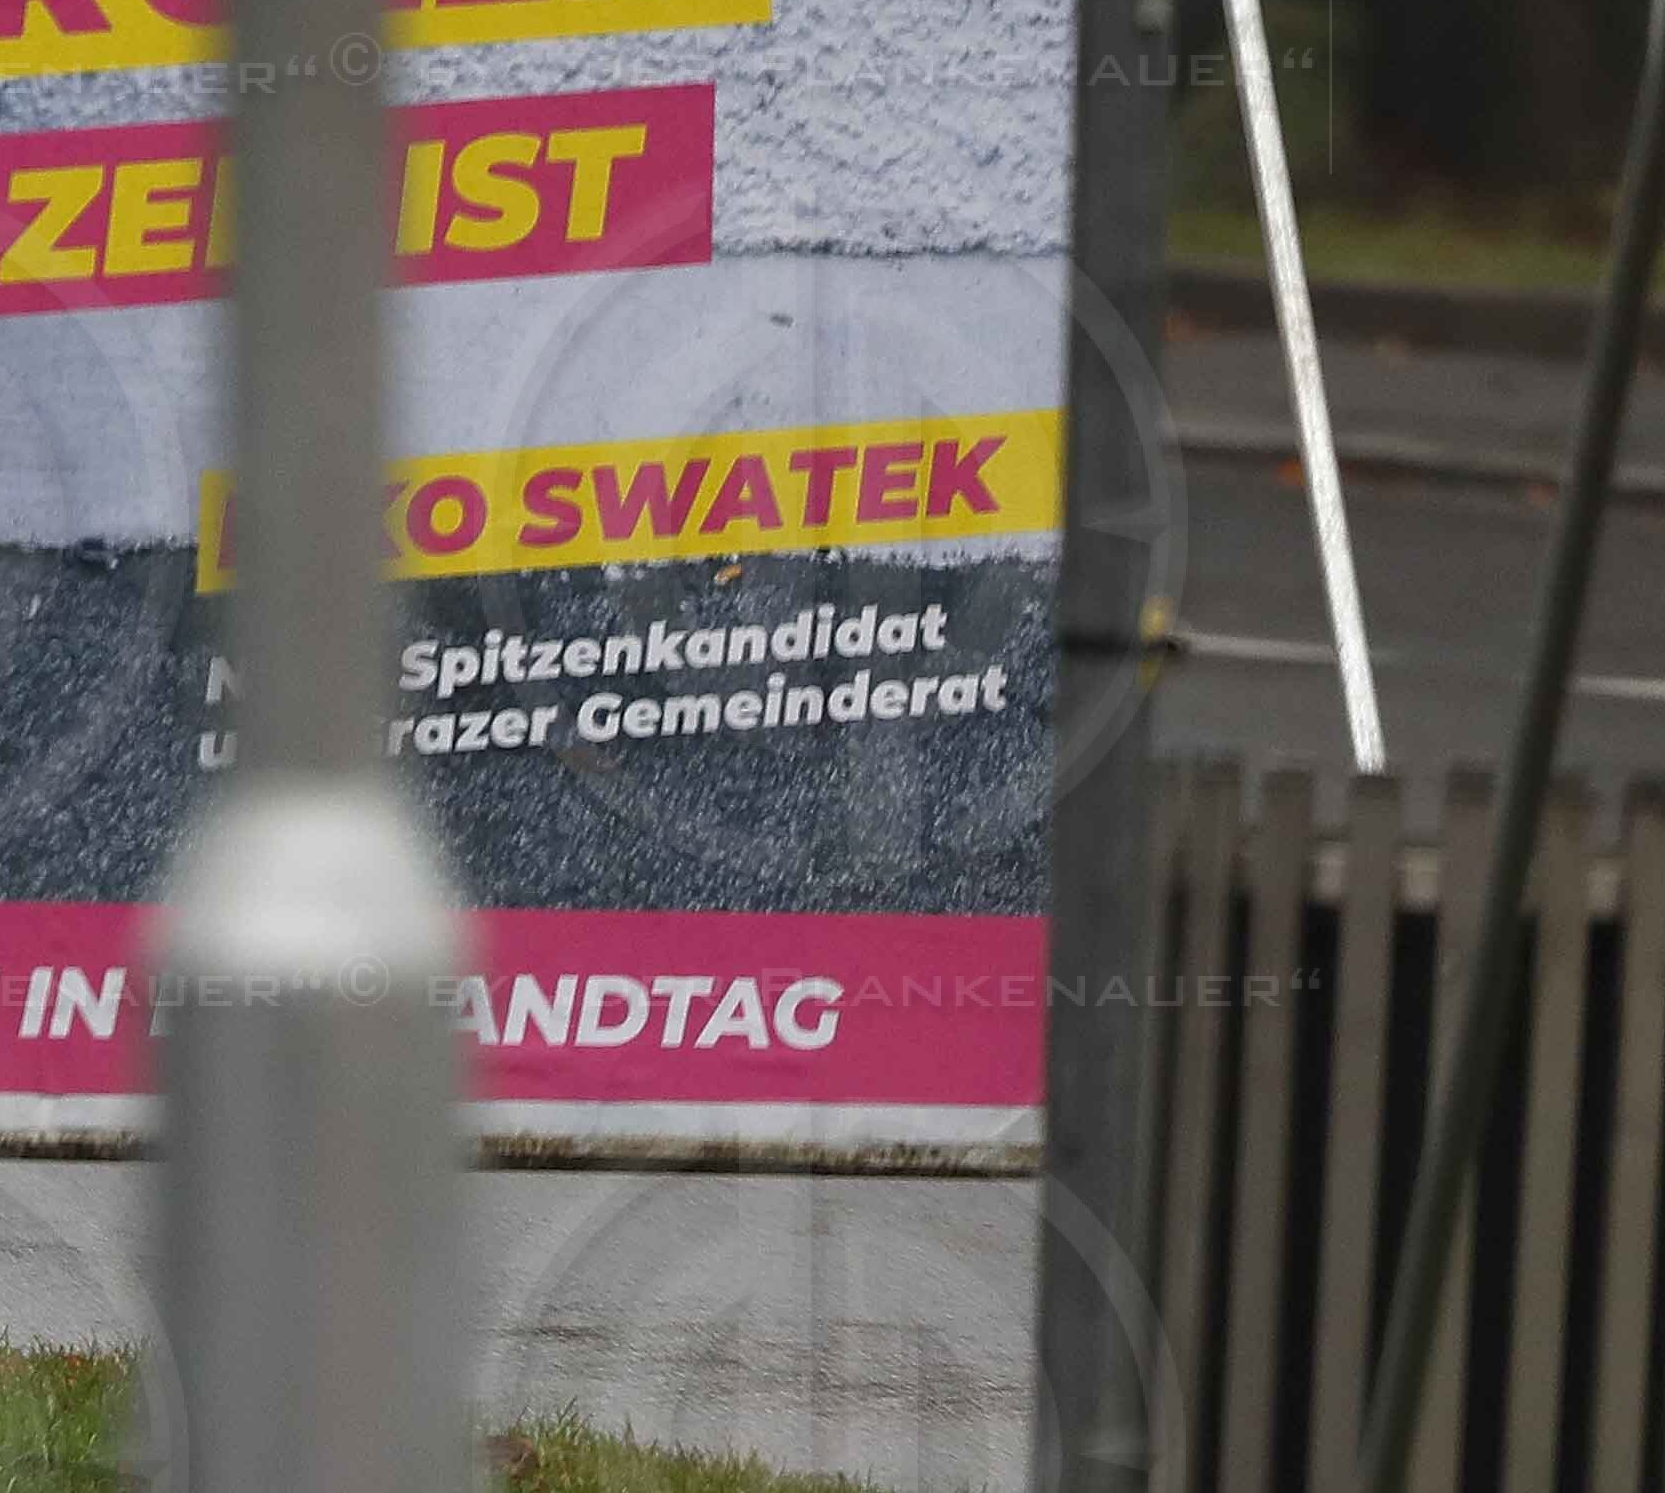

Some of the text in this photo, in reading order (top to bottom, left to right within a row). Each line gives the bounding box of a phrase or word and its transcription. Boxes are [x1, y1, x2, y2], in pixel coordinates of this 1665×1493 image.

[395, 124, 648, 258] IST
[517, 434, 1009, 549] SWATEK
[398, 599, 949, 697] Spitzenkandidat
[576, 661, 1009, 746] Gemeinderat
[17, 965, 126, 1041] IN
